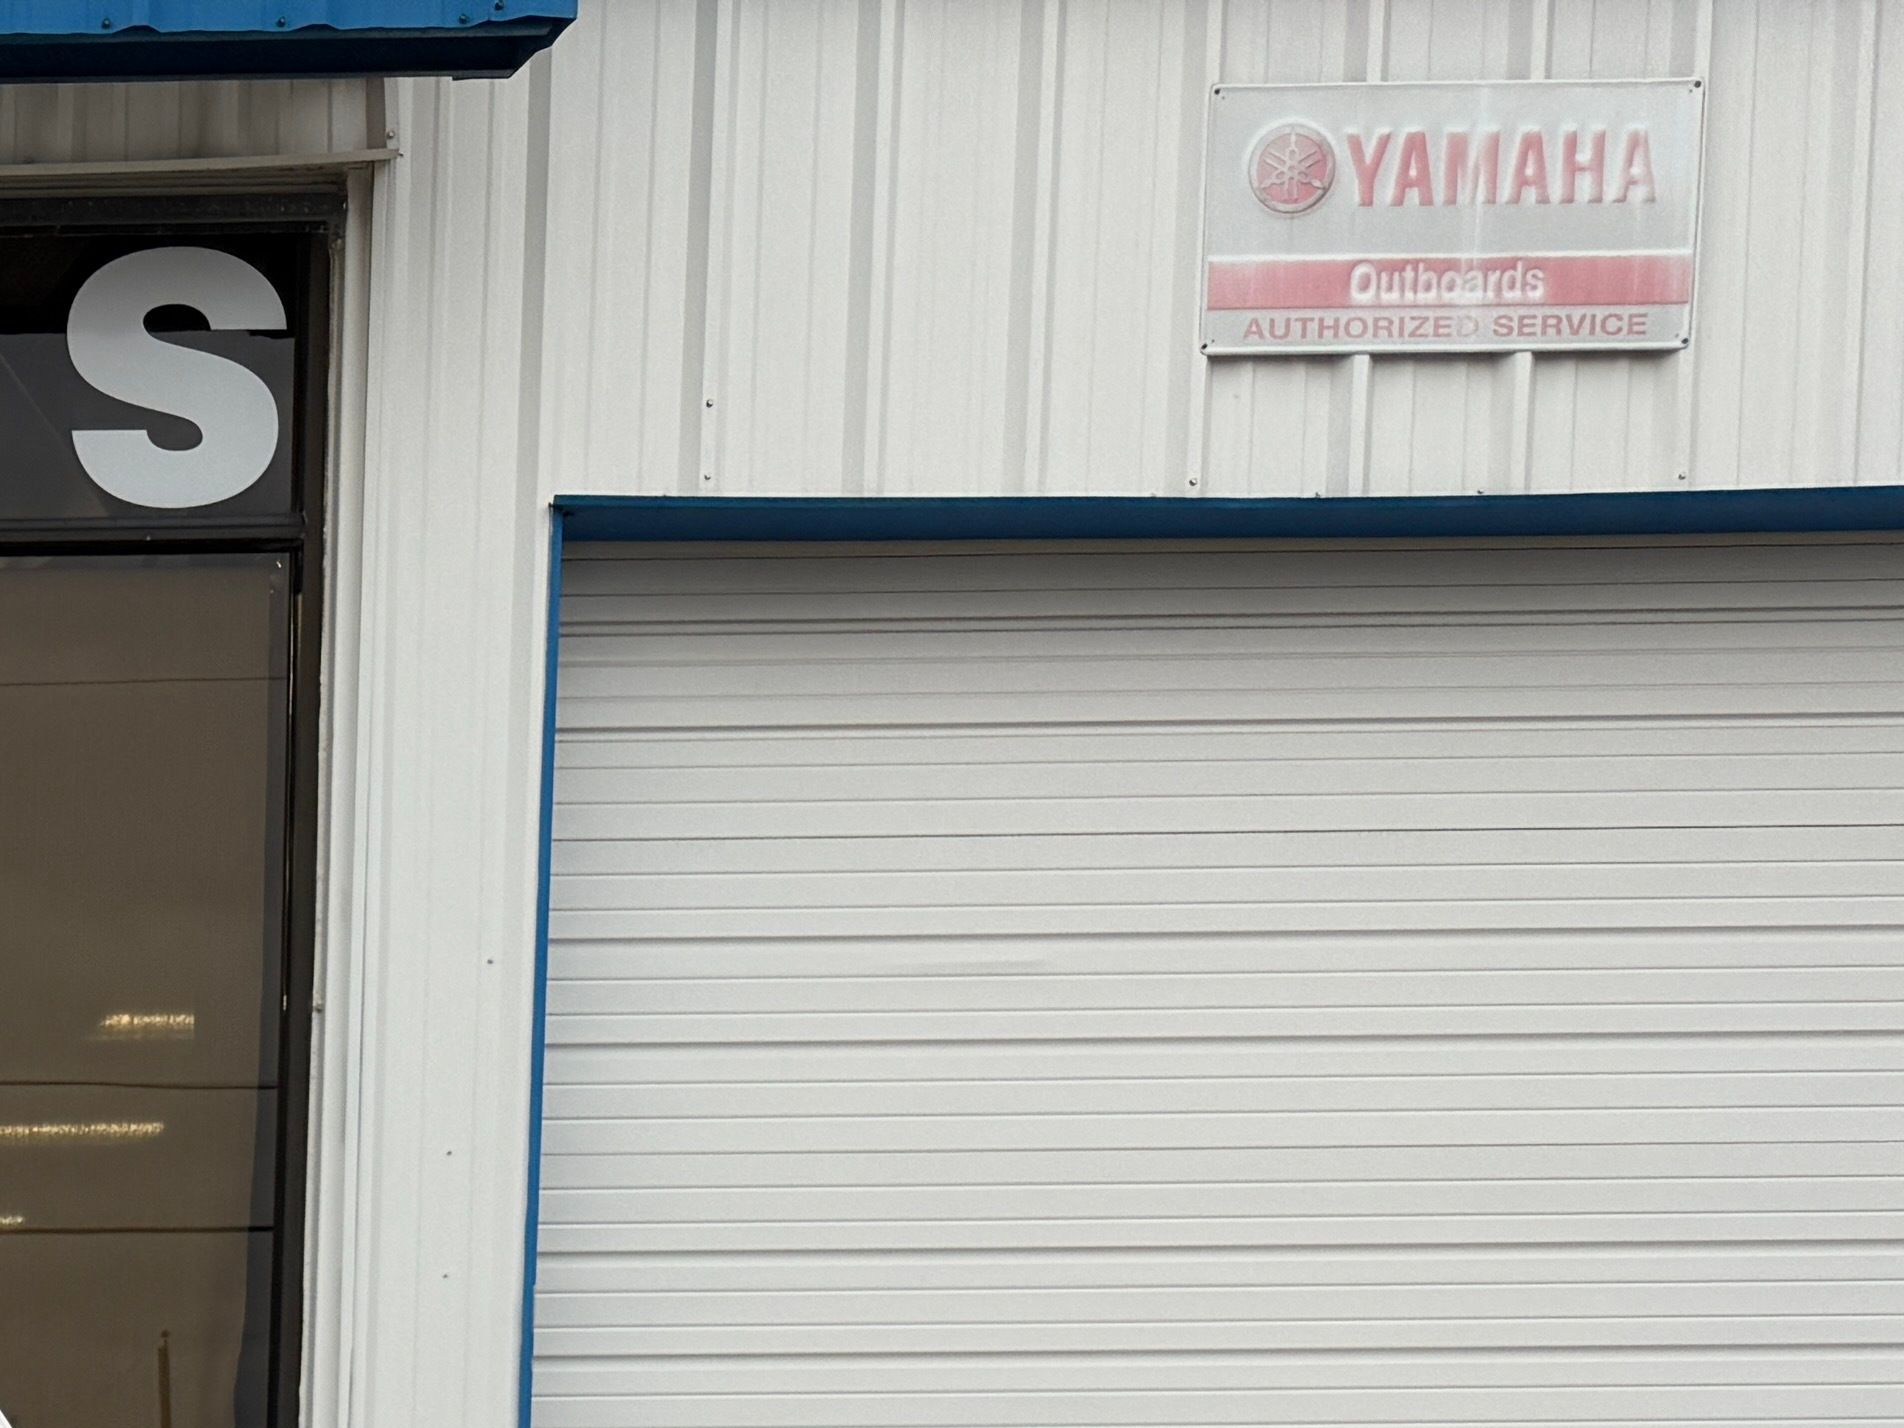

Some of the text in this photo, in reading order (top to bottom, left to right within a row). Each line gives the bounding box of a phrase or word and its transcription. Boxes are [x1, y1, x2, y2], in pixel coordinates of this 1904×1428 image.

[1345, 129, 1657, 208] YAMAHA
[1349, 261, 1546, 304] Outboards
[1242, 312, 1649, 342] AUTHORIZED SERVICE
